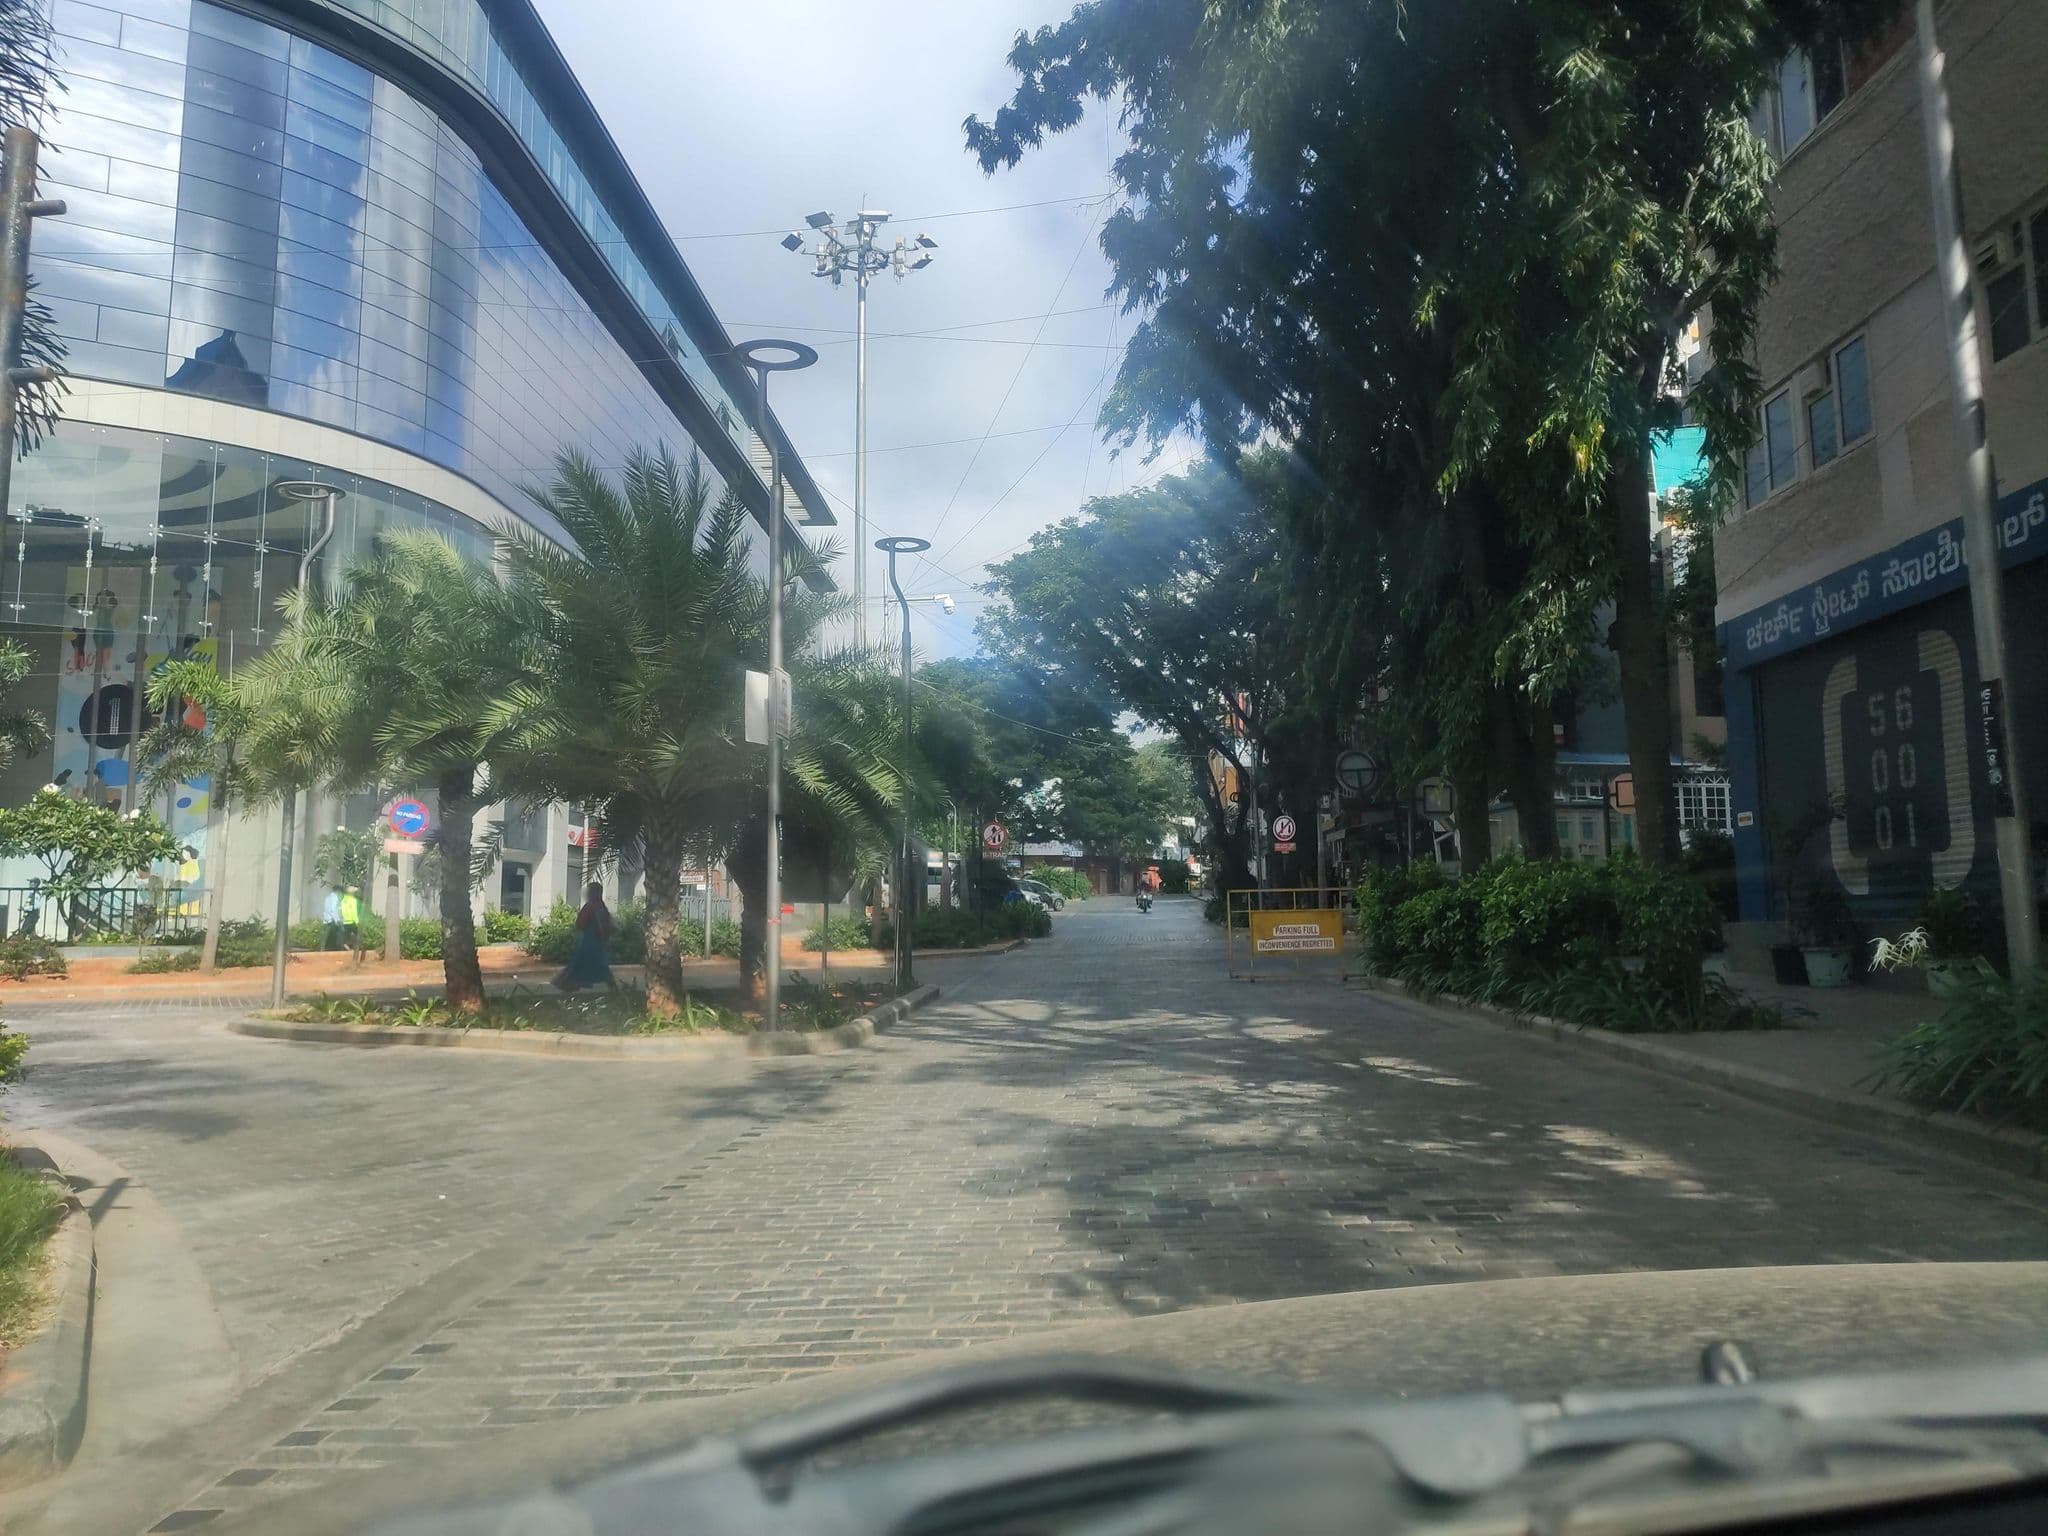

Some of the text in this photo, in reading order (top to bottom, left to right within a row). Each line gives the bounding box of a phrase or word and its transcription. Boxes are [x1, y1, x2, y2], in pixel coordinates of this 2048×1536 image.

[1882, 491, 2047, 599] ಸೋಶಿಲ್
[1869, 685, 1913, 737] 56
[1872, 743, 1917, 793] 00
[1258, 941, 1301, 950] INCONVENIENCE
[1275, 926, 1318, 935] PARKING FULL
